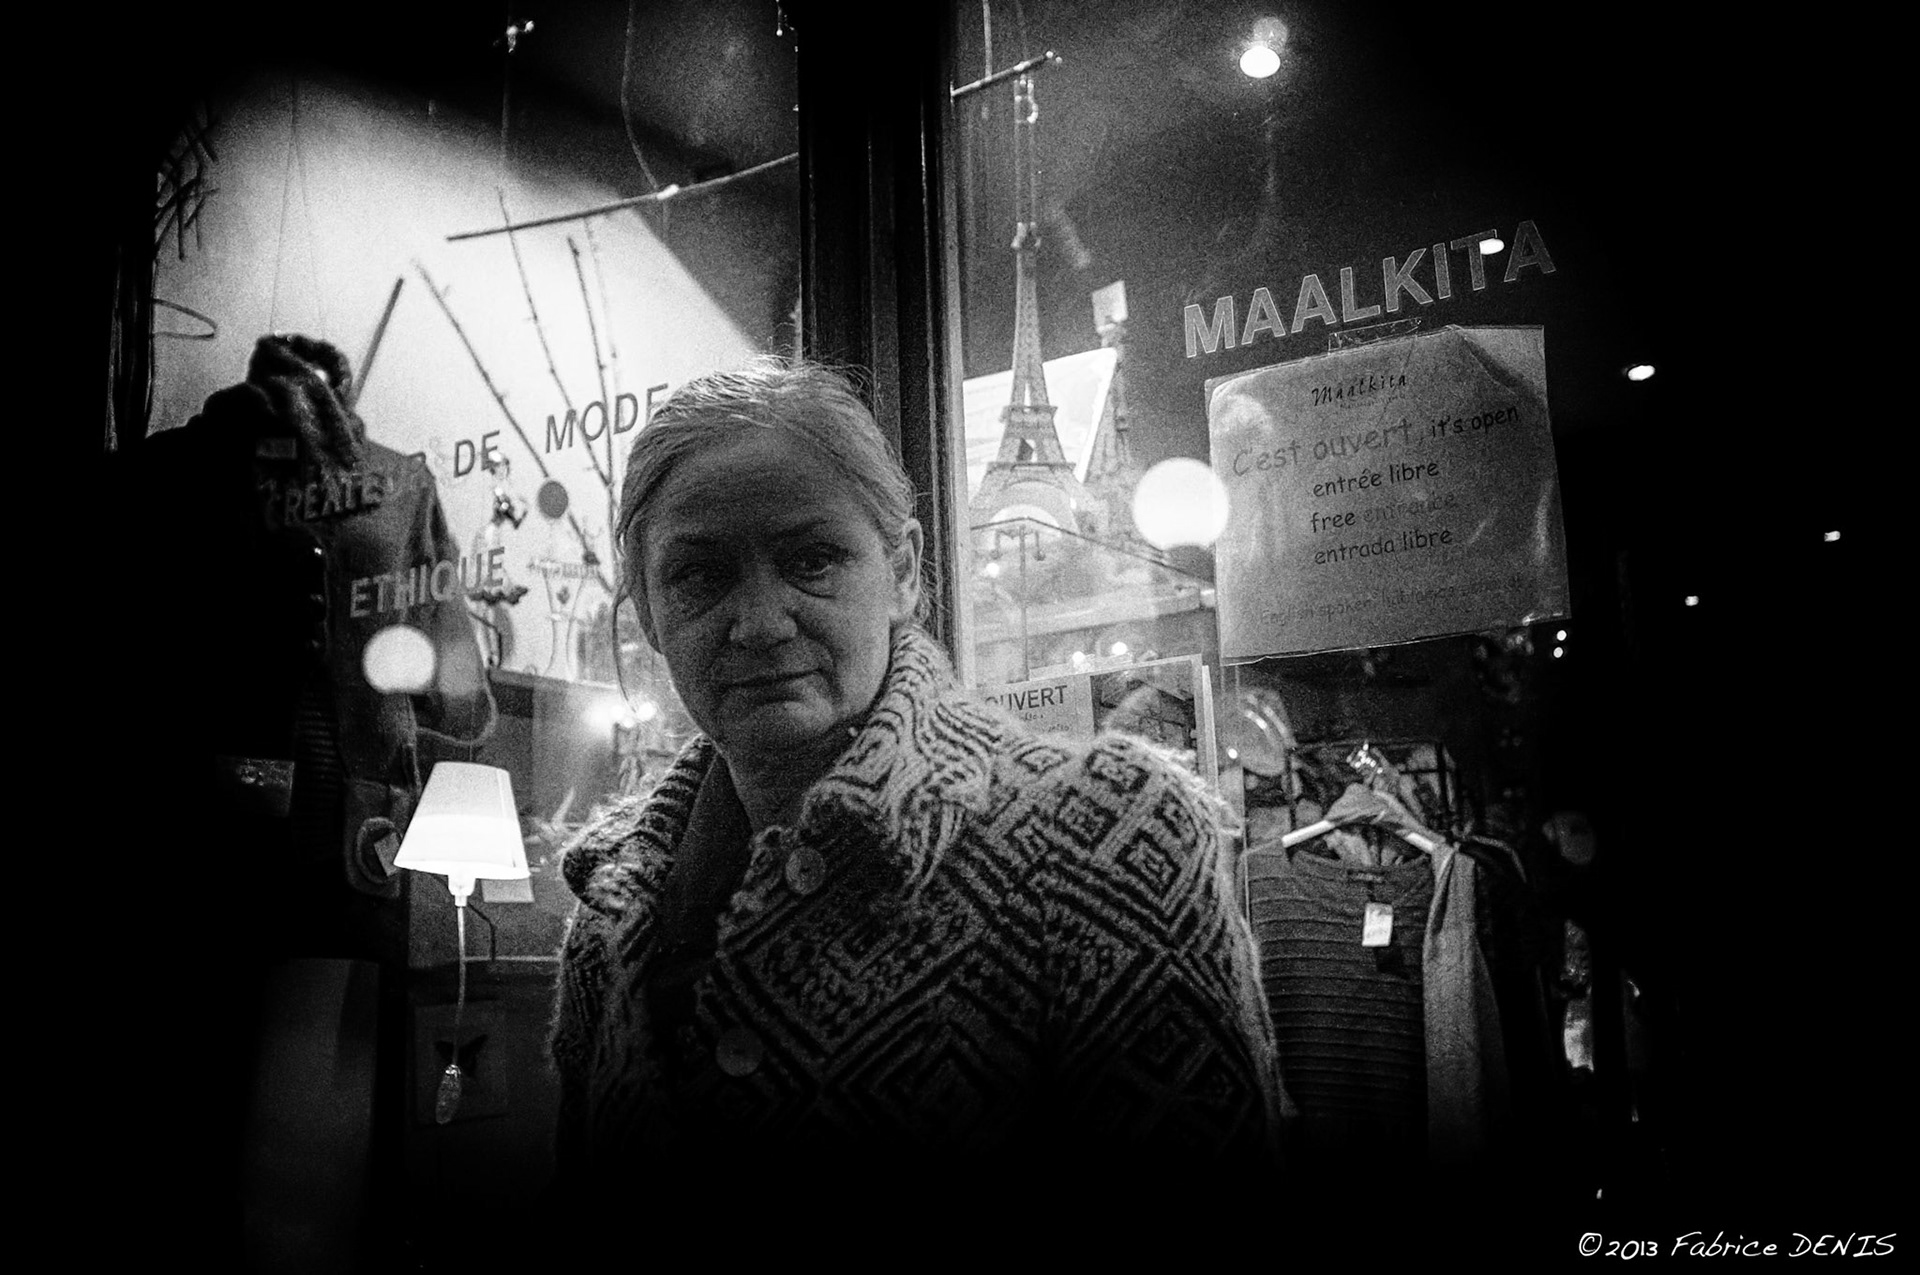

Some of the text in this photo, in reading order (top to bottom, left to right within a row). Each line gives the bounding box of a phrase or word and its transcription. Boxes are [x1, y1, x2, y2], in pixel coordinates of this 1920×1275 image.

[1184, 219, 1557, 358] MAALKITA
[1311, 374, 1406, 406] Maalkita
[453, 430, 502, 478] DE
[1233, 440, 1301, 477] C'est
[1430, 415, 1464, 438] it's
[1471, 406, 1519, 434] open
[1313, 461, 1440, 497] entrée libre
[1310, 512, 1356, 533] free
[1314, 527, 1453, 565] entrada libre
[350, 546, 505, 618] ETHIQUE
